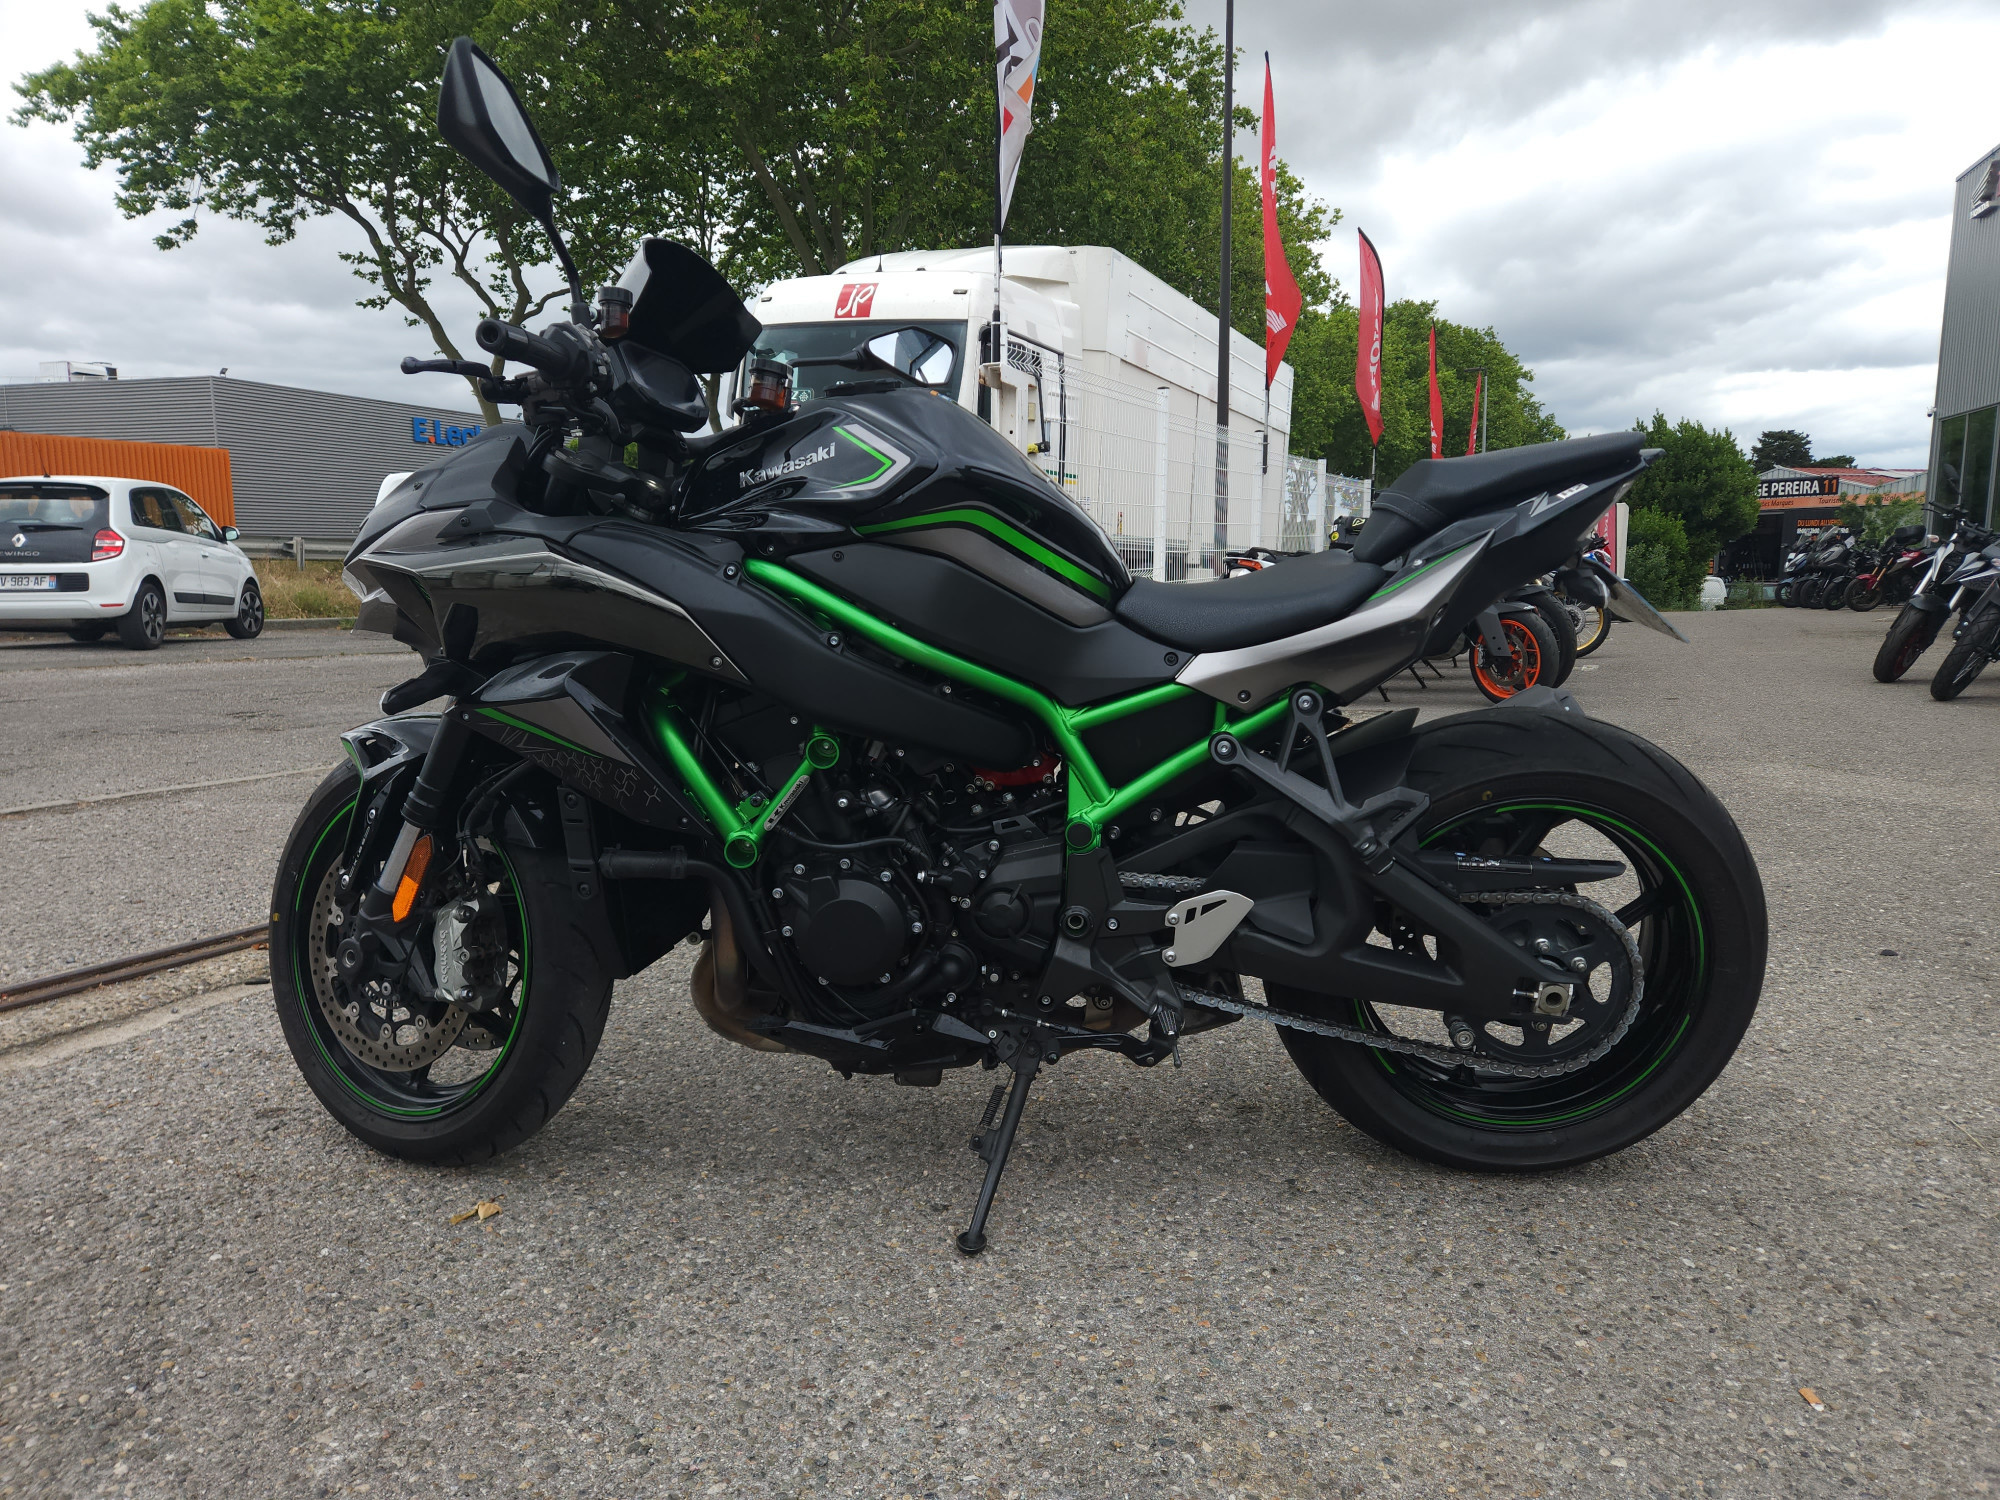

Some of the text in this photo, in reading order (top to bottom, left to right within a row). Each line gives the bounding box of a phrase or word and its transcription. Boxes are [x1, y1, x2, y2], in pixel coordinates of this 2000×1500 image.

[739, 442, 836, 488] Kawasaki
[1757, 479, 1838, 497] GE PEREIRA 11
[440, 929, 450, 984] brembo
